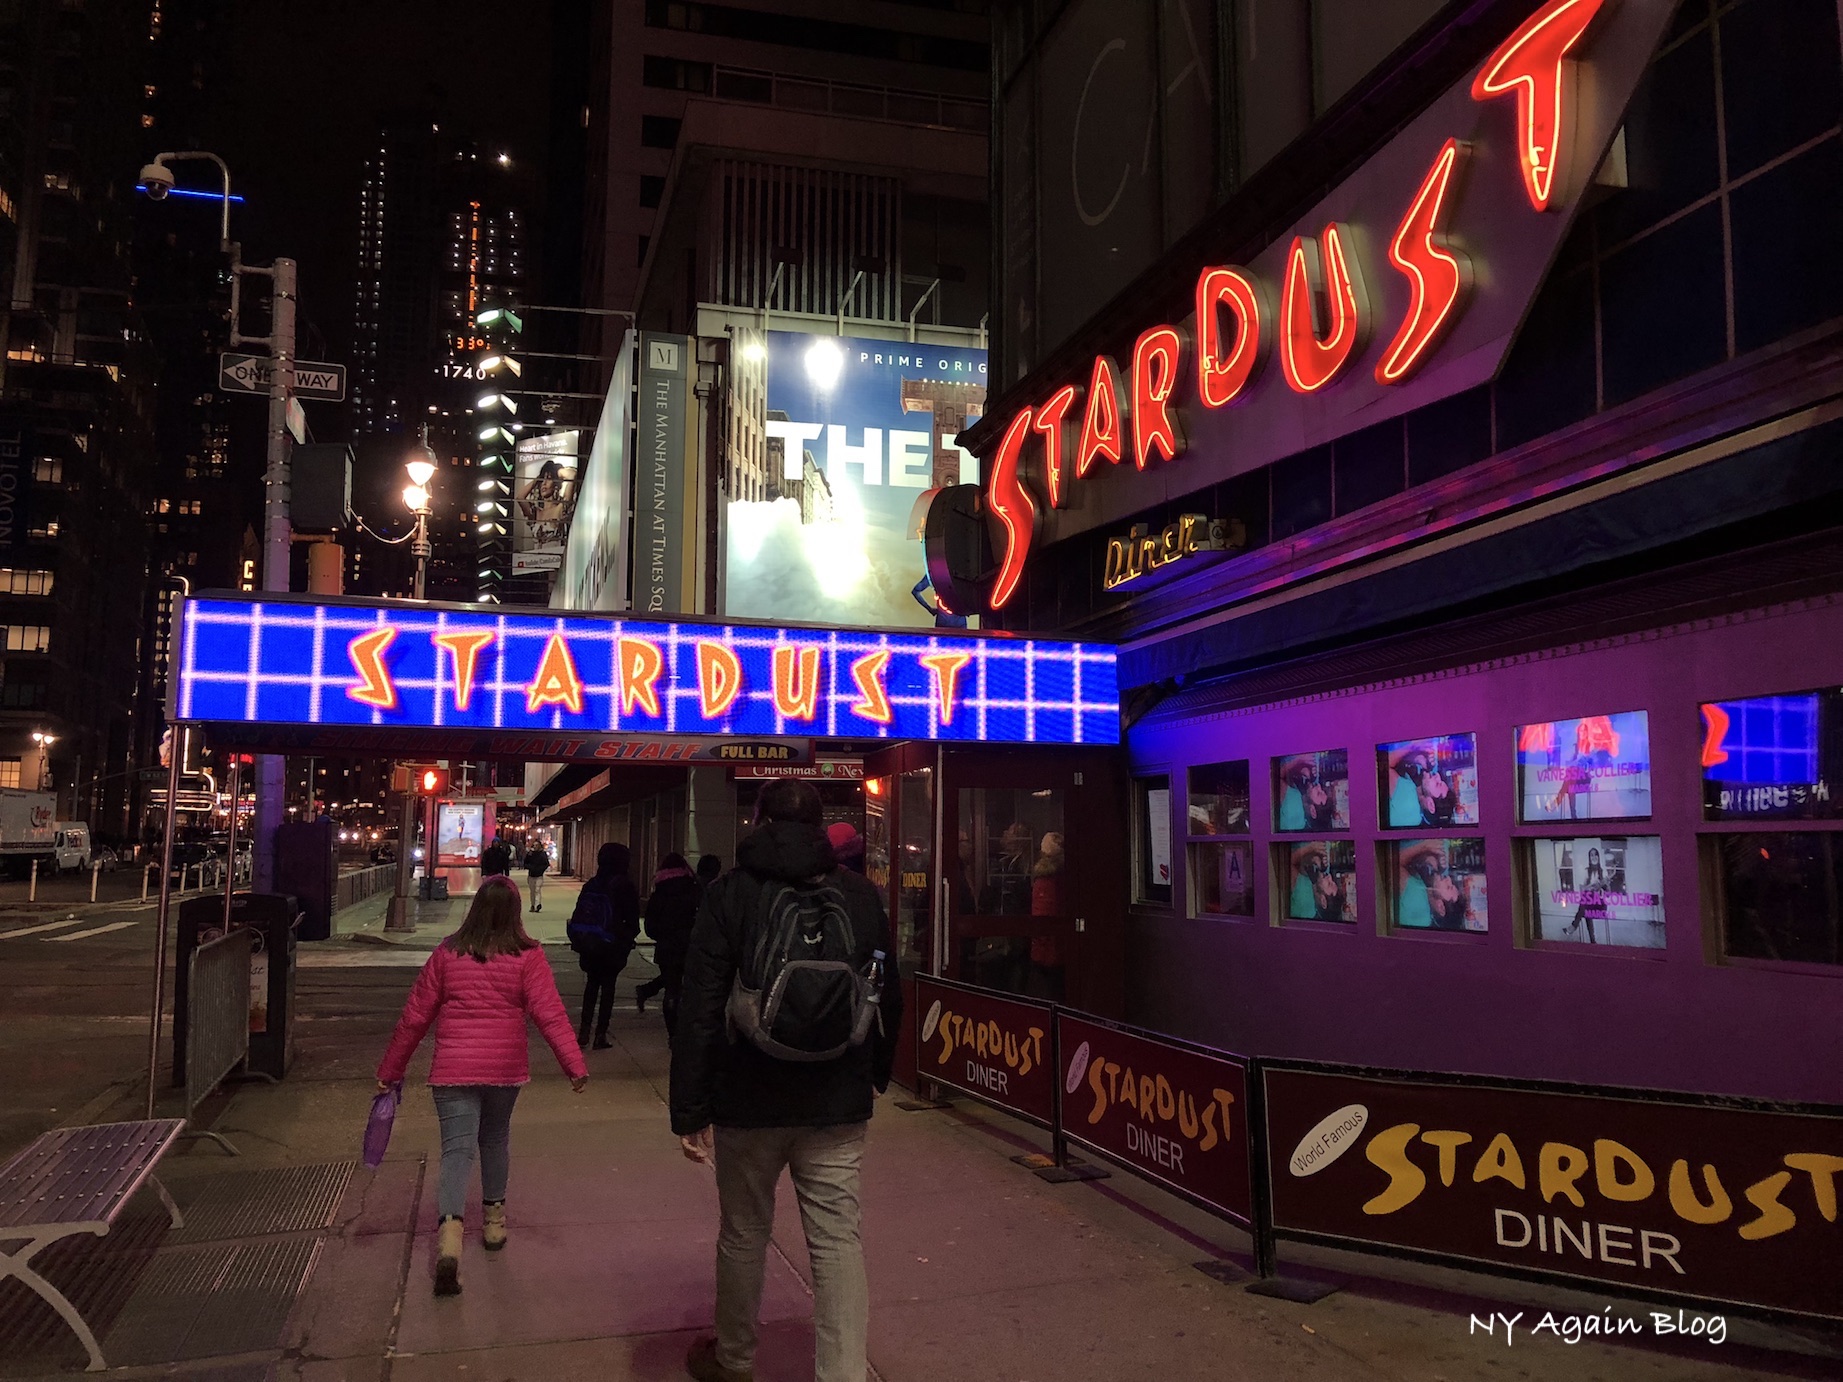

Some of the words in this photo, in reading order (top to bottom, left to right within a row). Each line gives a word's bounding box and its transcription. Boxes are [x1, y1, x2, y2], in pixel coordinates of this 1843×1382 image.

[989, 0, 1602, 610] STARDUST
[442, 364, 487, 381] 1740
[656, 347, 672, 365] M
[860, 352, 923, 368] PRIME
[938, 359, 987, 373] ORIG
[296, 372, 334, 388] WAY
[656, 380, 669, 409] THE
[653, 413, 669, 511] MANHATTAN
[765, 420, 931, 489] THE
[0, 431, 22, 545] NOVOTEL
[653, 514, 665, 533] AT
[651, 537, 666, 582] TIMES
[347, 627, 970, 725] STARDUST
[310, 730, 477, 751] SINGING
[491, 736, 588, 757] WAIT
[594, 740, 702, 760] STAFF
[720, 745, 754, 759] FULL
[757, 747, 789, 761] BAR
[752, 766, 817, 777] Christmas
[903, 872, 927, 887] DINER
[1229, 850, 1242, 880] A
[1602, 892, 1653, 906] COLLIER
[938, 1010, 1044, 1076] STARDUST
[967, 1060, 1009, 1095] DINER
[1088, 1056, 1235, 1151] STARDUST
[1126, 1122, 1185, 1175] DINER
[1293, 1141, 1326, 1172] World
[1321, 1111, 1364, 1147] Famous
[1362, 1122, 1843, 1240] STARDUST
[1494, 1208, 1686, 1275] DINER
